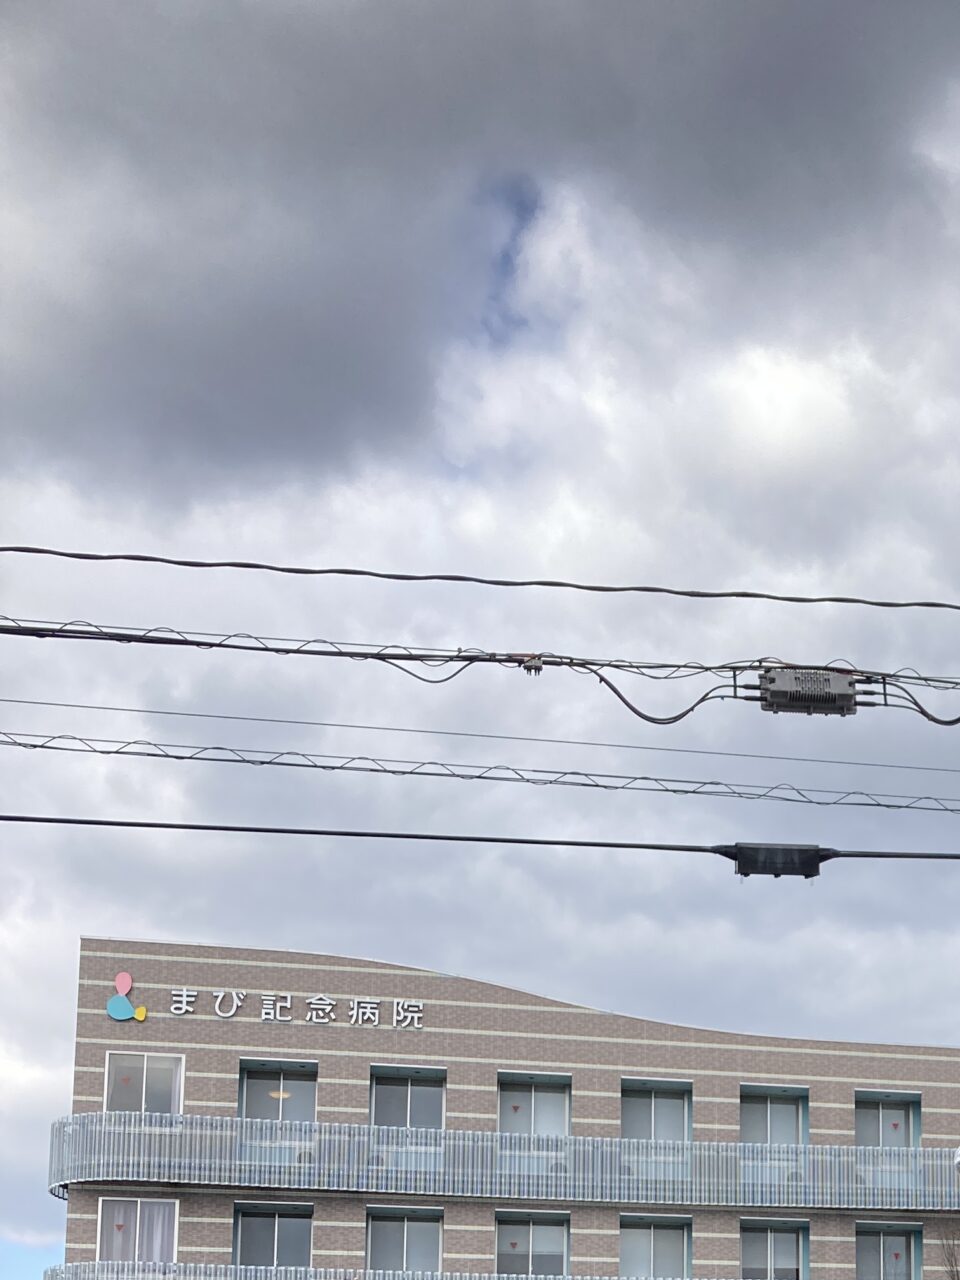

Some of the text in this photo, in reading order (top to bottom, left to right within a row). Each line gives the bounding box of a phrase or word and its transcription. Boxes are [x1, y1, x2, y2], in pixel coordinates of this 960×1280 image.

[169, 987, 425, 1029] まび記念病院
